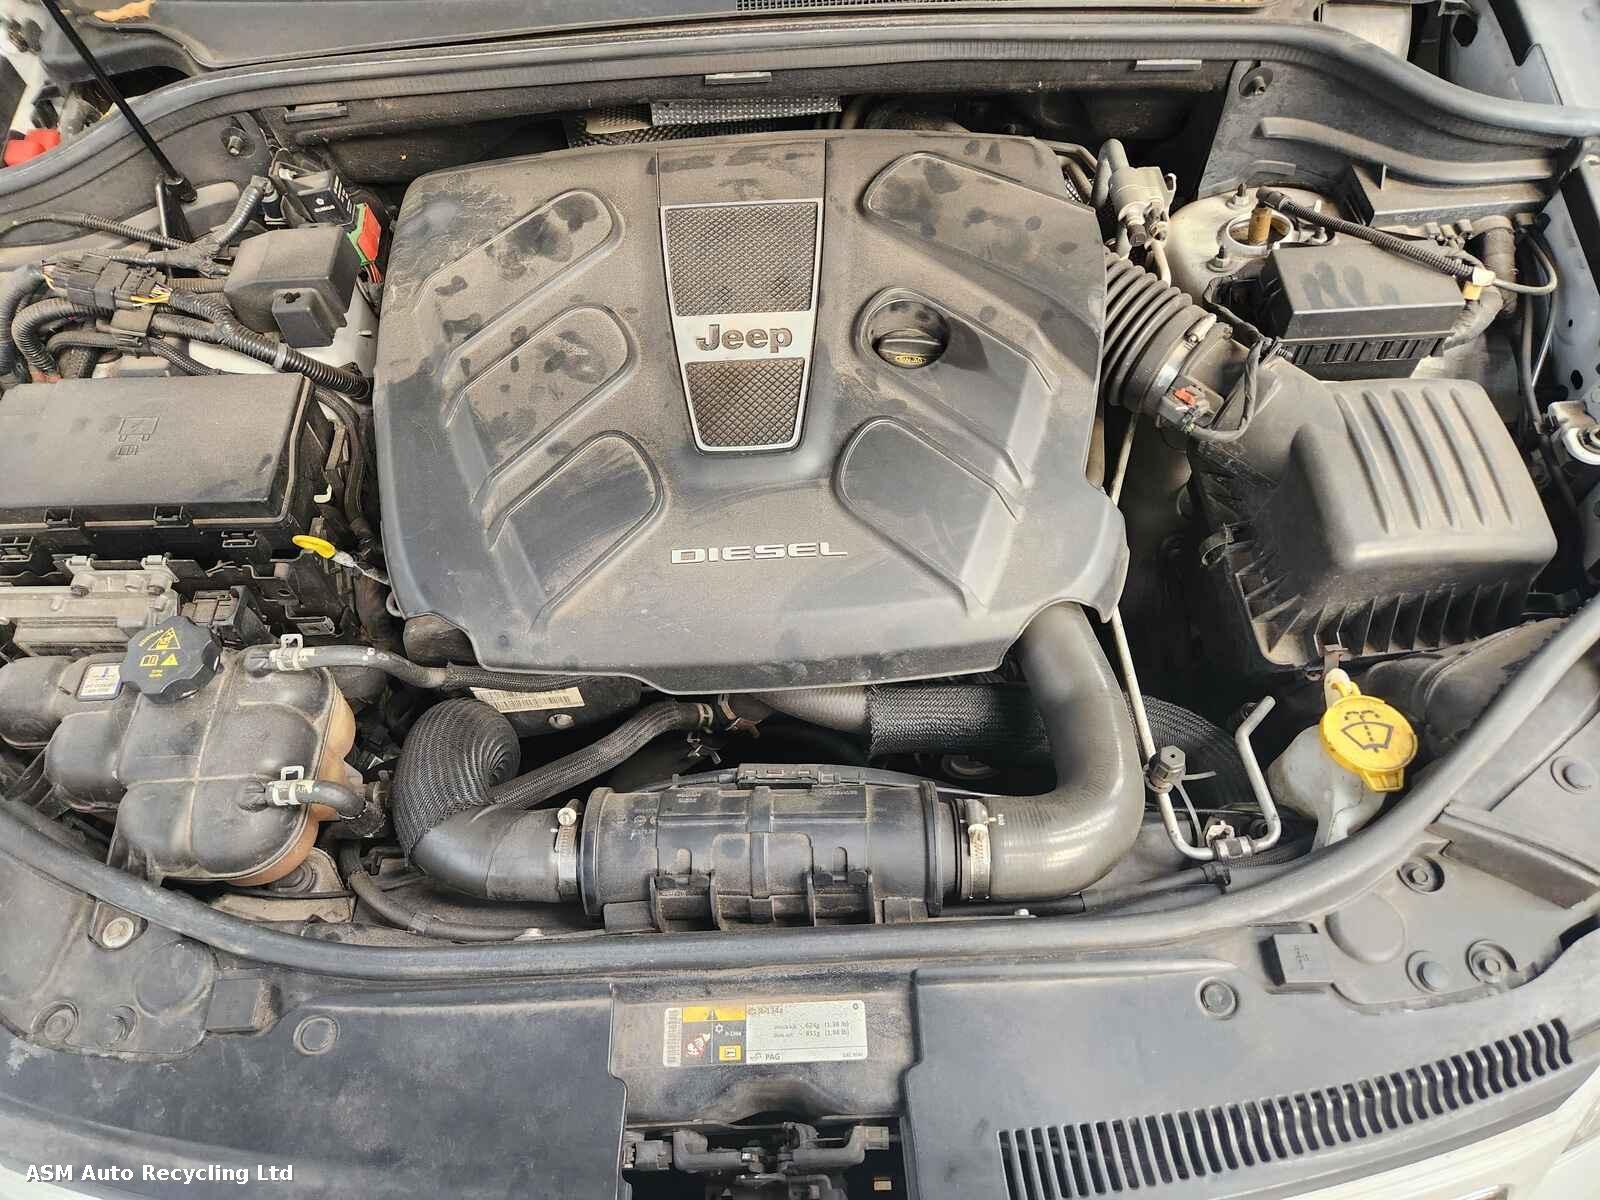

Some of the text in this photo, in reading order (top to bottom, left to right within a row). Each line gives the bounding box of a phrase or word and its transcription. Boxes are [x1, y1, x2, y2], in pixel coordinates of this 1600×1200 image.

[696, 323, 793, 353] Jeep
[671, 541, 849, 564] DIESEL
[765, 1053, 781, 1061] PAG
